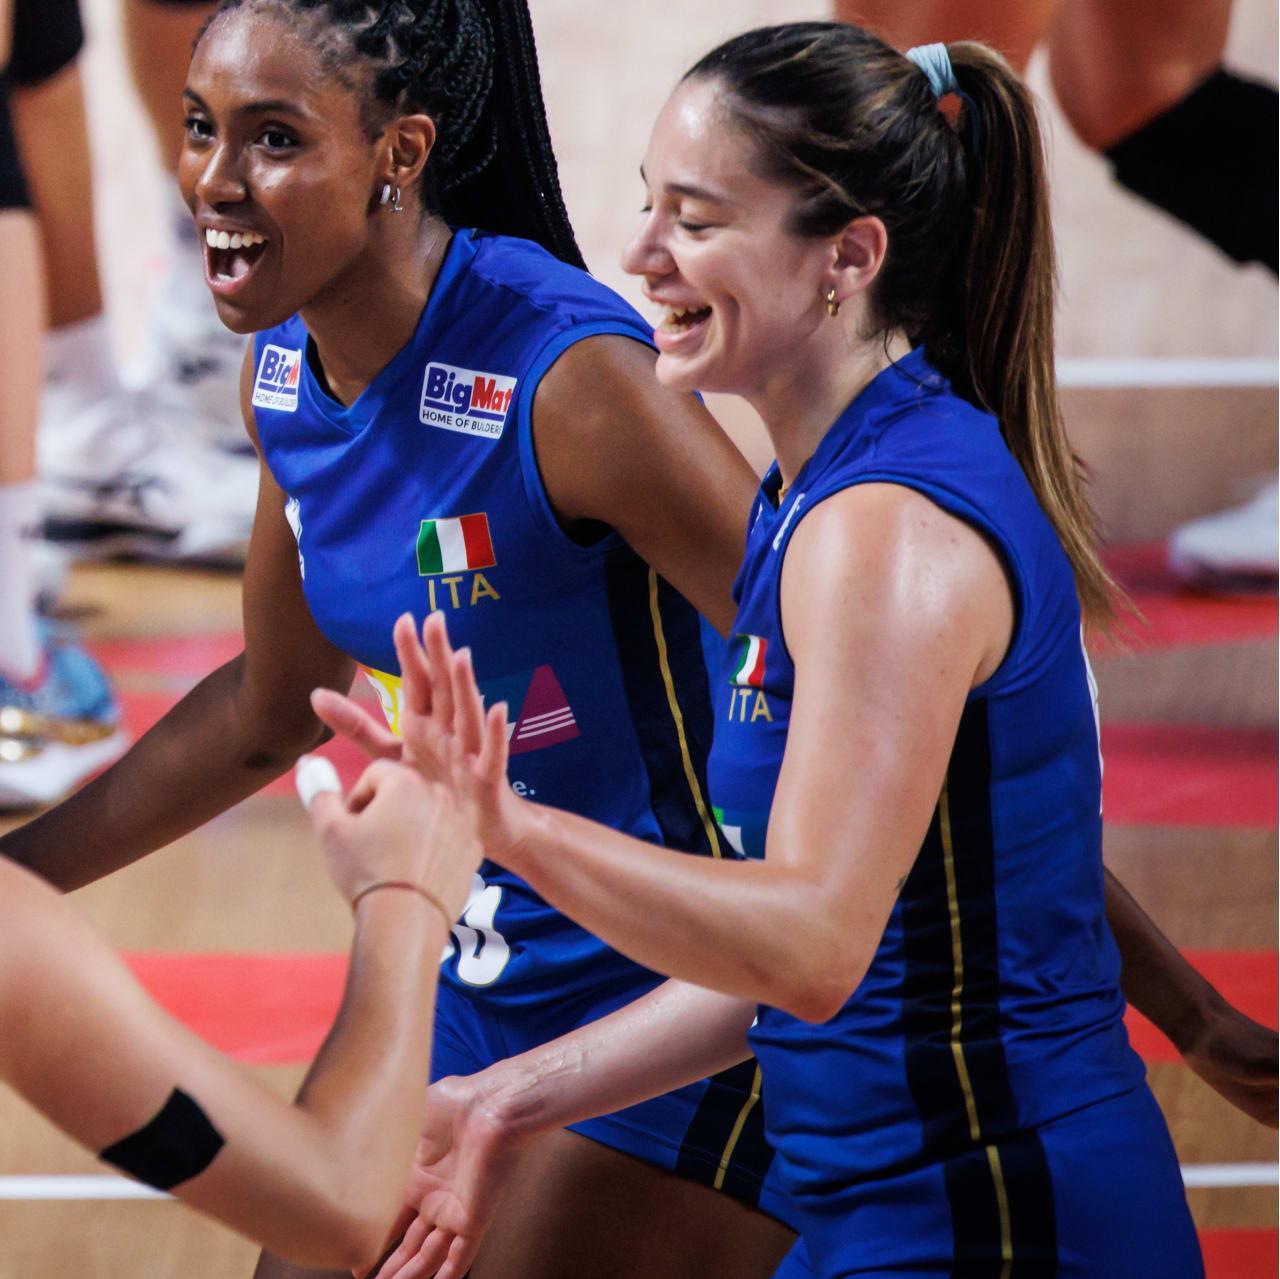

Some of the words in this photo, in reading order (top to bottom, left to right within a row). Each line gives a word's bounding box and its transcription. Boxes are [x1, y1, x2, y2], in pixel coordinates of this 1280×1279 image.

[425, 366, 513, 415] BigMat
[422, 409, 453, 426] HOME
[455, 417, 471, 429] OF
[428, 573, 501, 612] ITA
[728, 687, 774, 723] ITA
